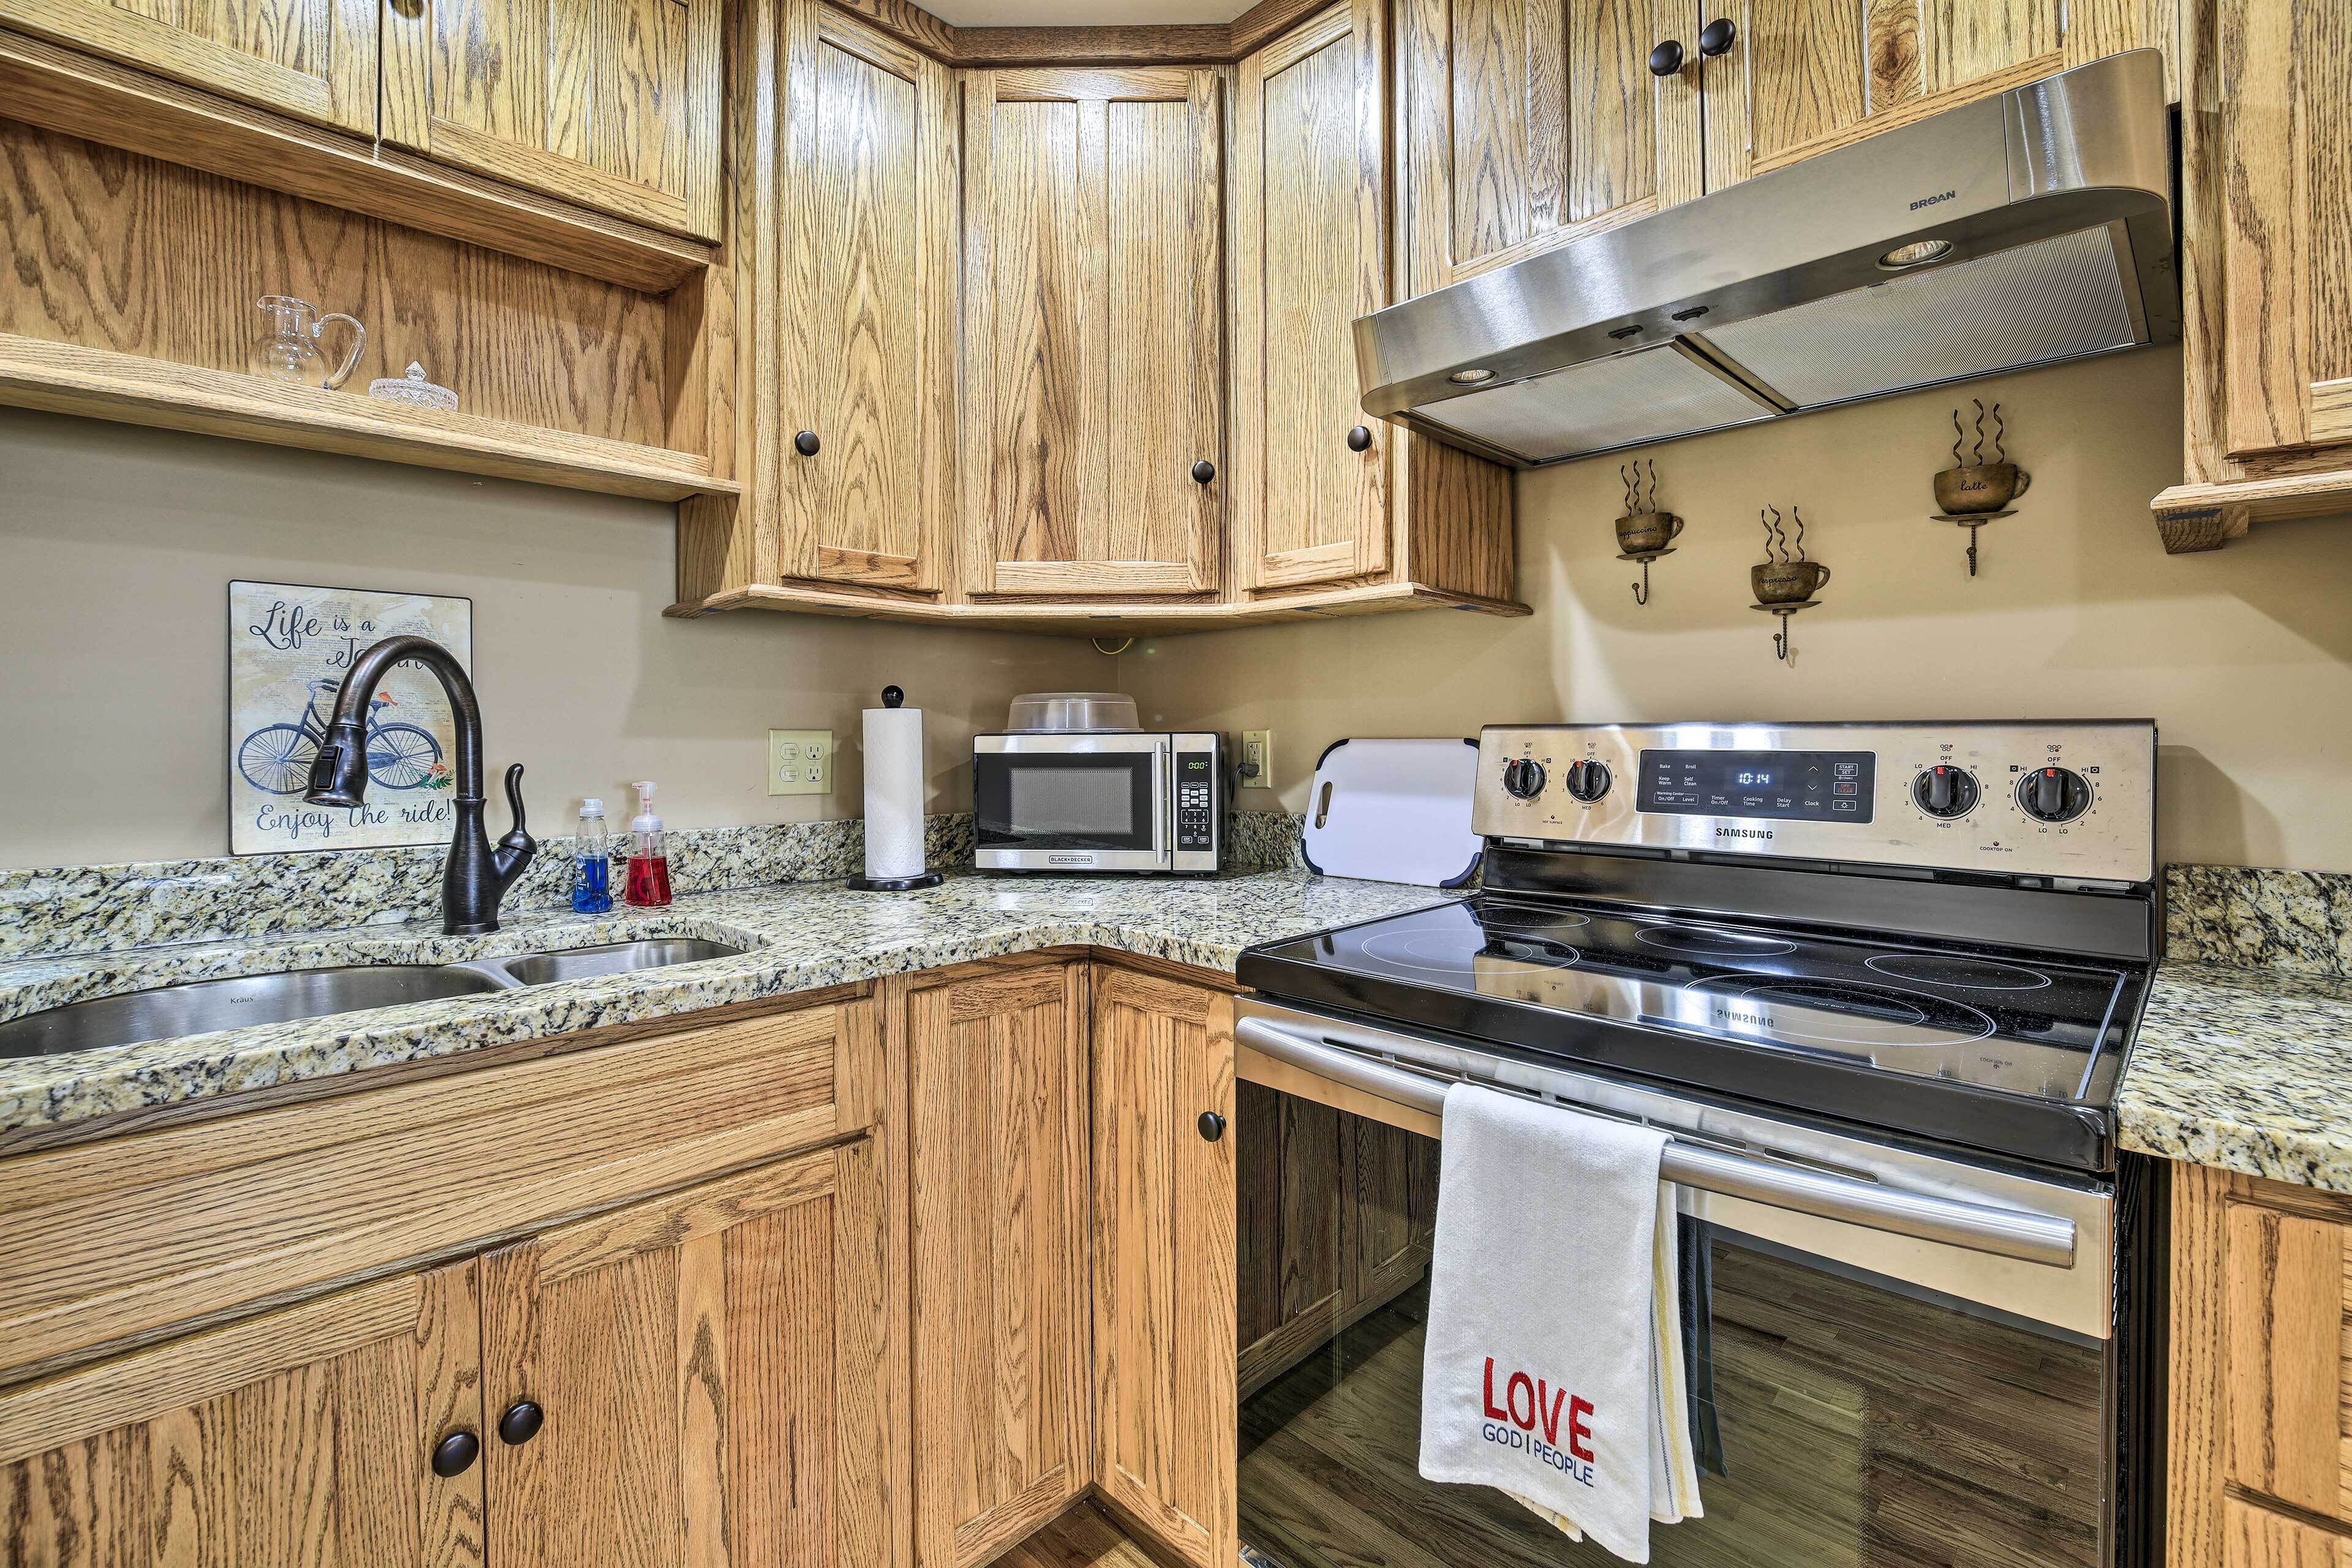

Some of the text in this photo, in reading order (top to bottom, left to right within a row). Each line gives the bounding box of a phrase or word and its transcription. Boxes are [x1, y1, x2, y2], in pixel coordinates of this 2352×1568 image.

[1910, 190, 1956, 211] BROAN
[1961, 480, 1988, 491] latte
[1760, 576, 1798, 587] espresso
[249, 601, 322, 650] Life
[334, 614, 350, 631] is
[361, 620, 375, 631] a
[1739, 773, 1770, 784] 10:14
[256, 804, 334, 840] Enjoy
[401, 799, 451, 823] ride!
[1716, 828, 1773, 839] SAMSUNG
[1483, 1356, 1595, 1464] LOVE
[1483, 1423, 1523, 1449] GOD
[1534, 1439, 1594, 1488] PEOPLE
